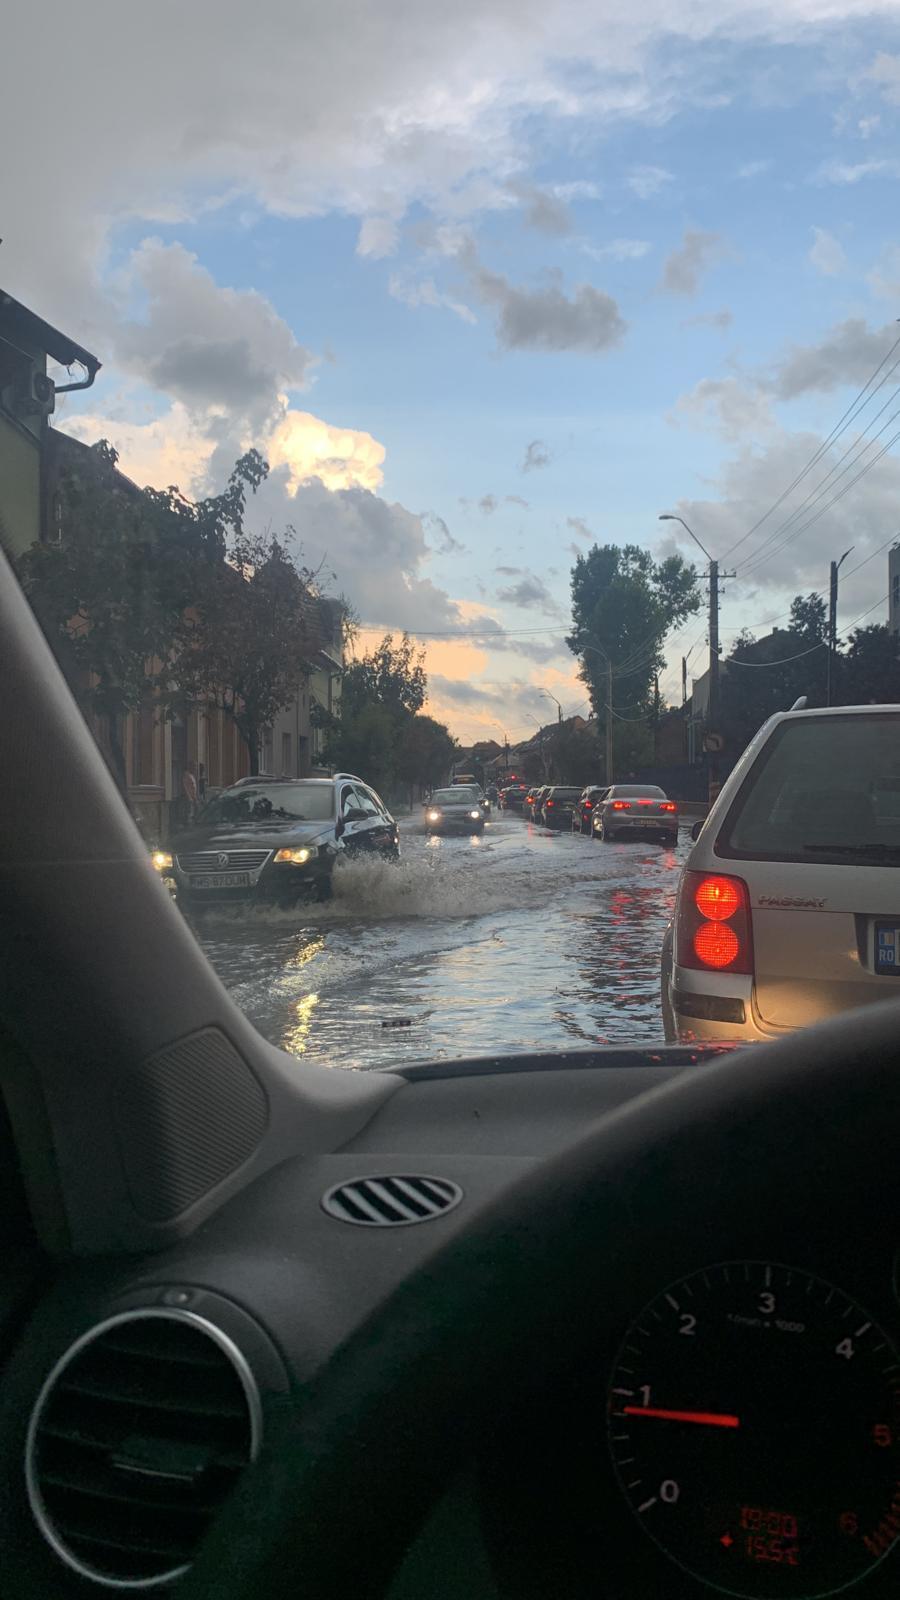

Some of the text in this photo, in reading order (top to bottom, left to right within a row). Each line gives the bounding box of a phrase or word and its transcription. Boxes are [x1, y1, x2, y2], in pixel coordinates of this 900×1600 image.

[758, 896, 828, 908] PASSAT
[879, 949, 894, 962] RO
[758, 1292, 776, 1314] 3
[679, 1314, 697, 1335] 2
[835, 1338, 855, 1359] 4
[639, 1384, 651, 1406] 1
[873, 1424, 892, 1447] 5
[660, 1479, 679, 1503] 0
